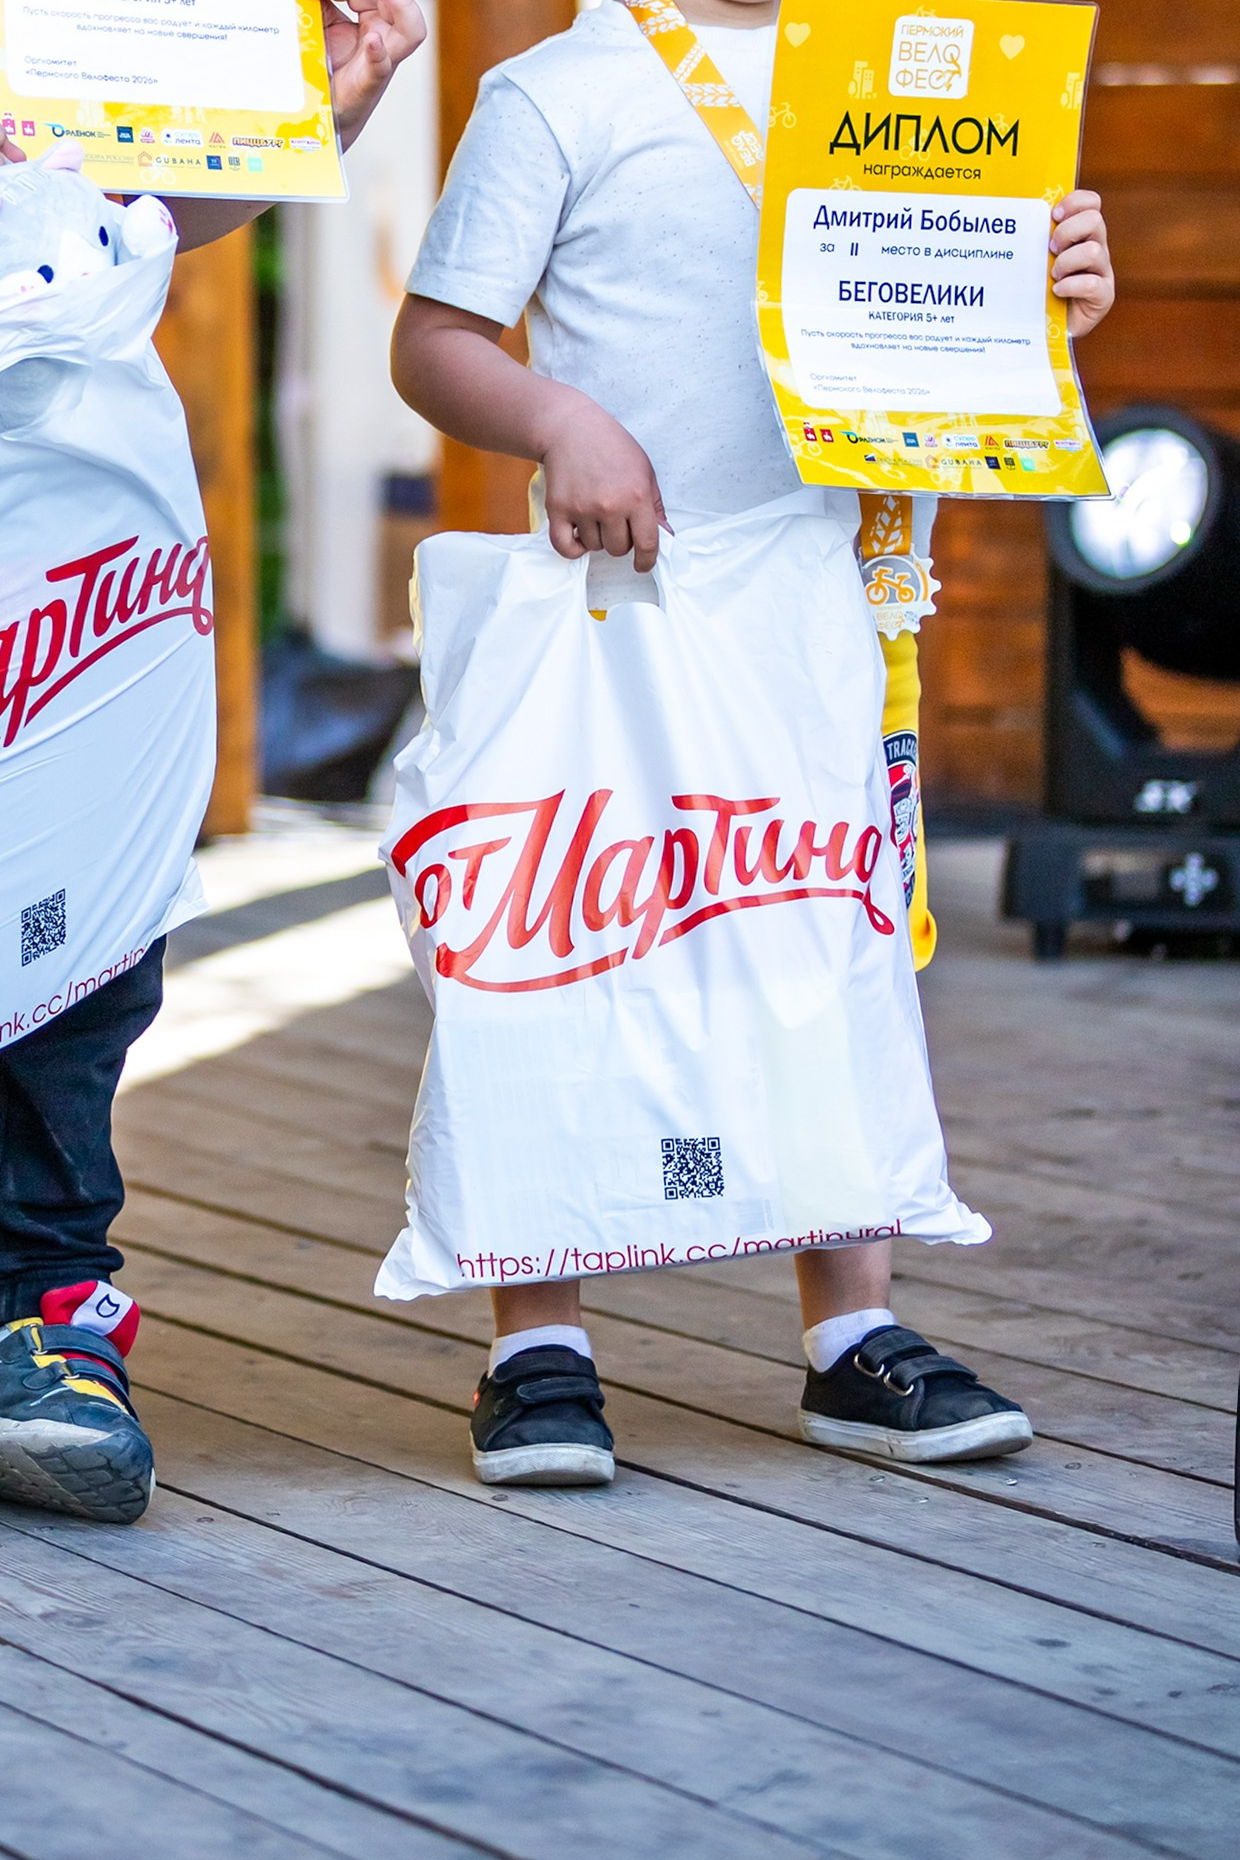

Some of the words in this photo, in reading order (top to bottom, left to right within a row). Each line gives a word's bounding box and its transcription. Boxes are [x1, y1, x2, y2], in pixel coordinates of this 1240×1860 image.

[901, 24, 964, 38] ПЕРМСКИЙ
[898, 41, 960, 64] ВЕЛО
[895, 68, 962, 92] ФЕСТ
[829, 110, 1020, 156] ДИПЛОМ
[863, 163, 981, 180] награждается
[813, 204, 912, 233] Дмитрий
[920, 209, 1017, 235] Бобылев
[819, 243, 835, 252] за
[881, 245, 921, 256] место
[924, 248, 931, 256] в
[934, 247, 1014, 260] дисциплине
[838, 280, 984, 307] БЕГОВЕЛИКИ
[868, 311, 924, 322] КАТЕГОРИЯ
[926, 314, 938, 323] 5+
[940, 315, 955, 324] лет
[801, 329, 825, 337] Пусть
[826, 331, 863, 339] скорость
[865, 332, 908, 340] прогресса
[413, 836, 512, 929] от
[436, 788, 896, 994] Мартина
